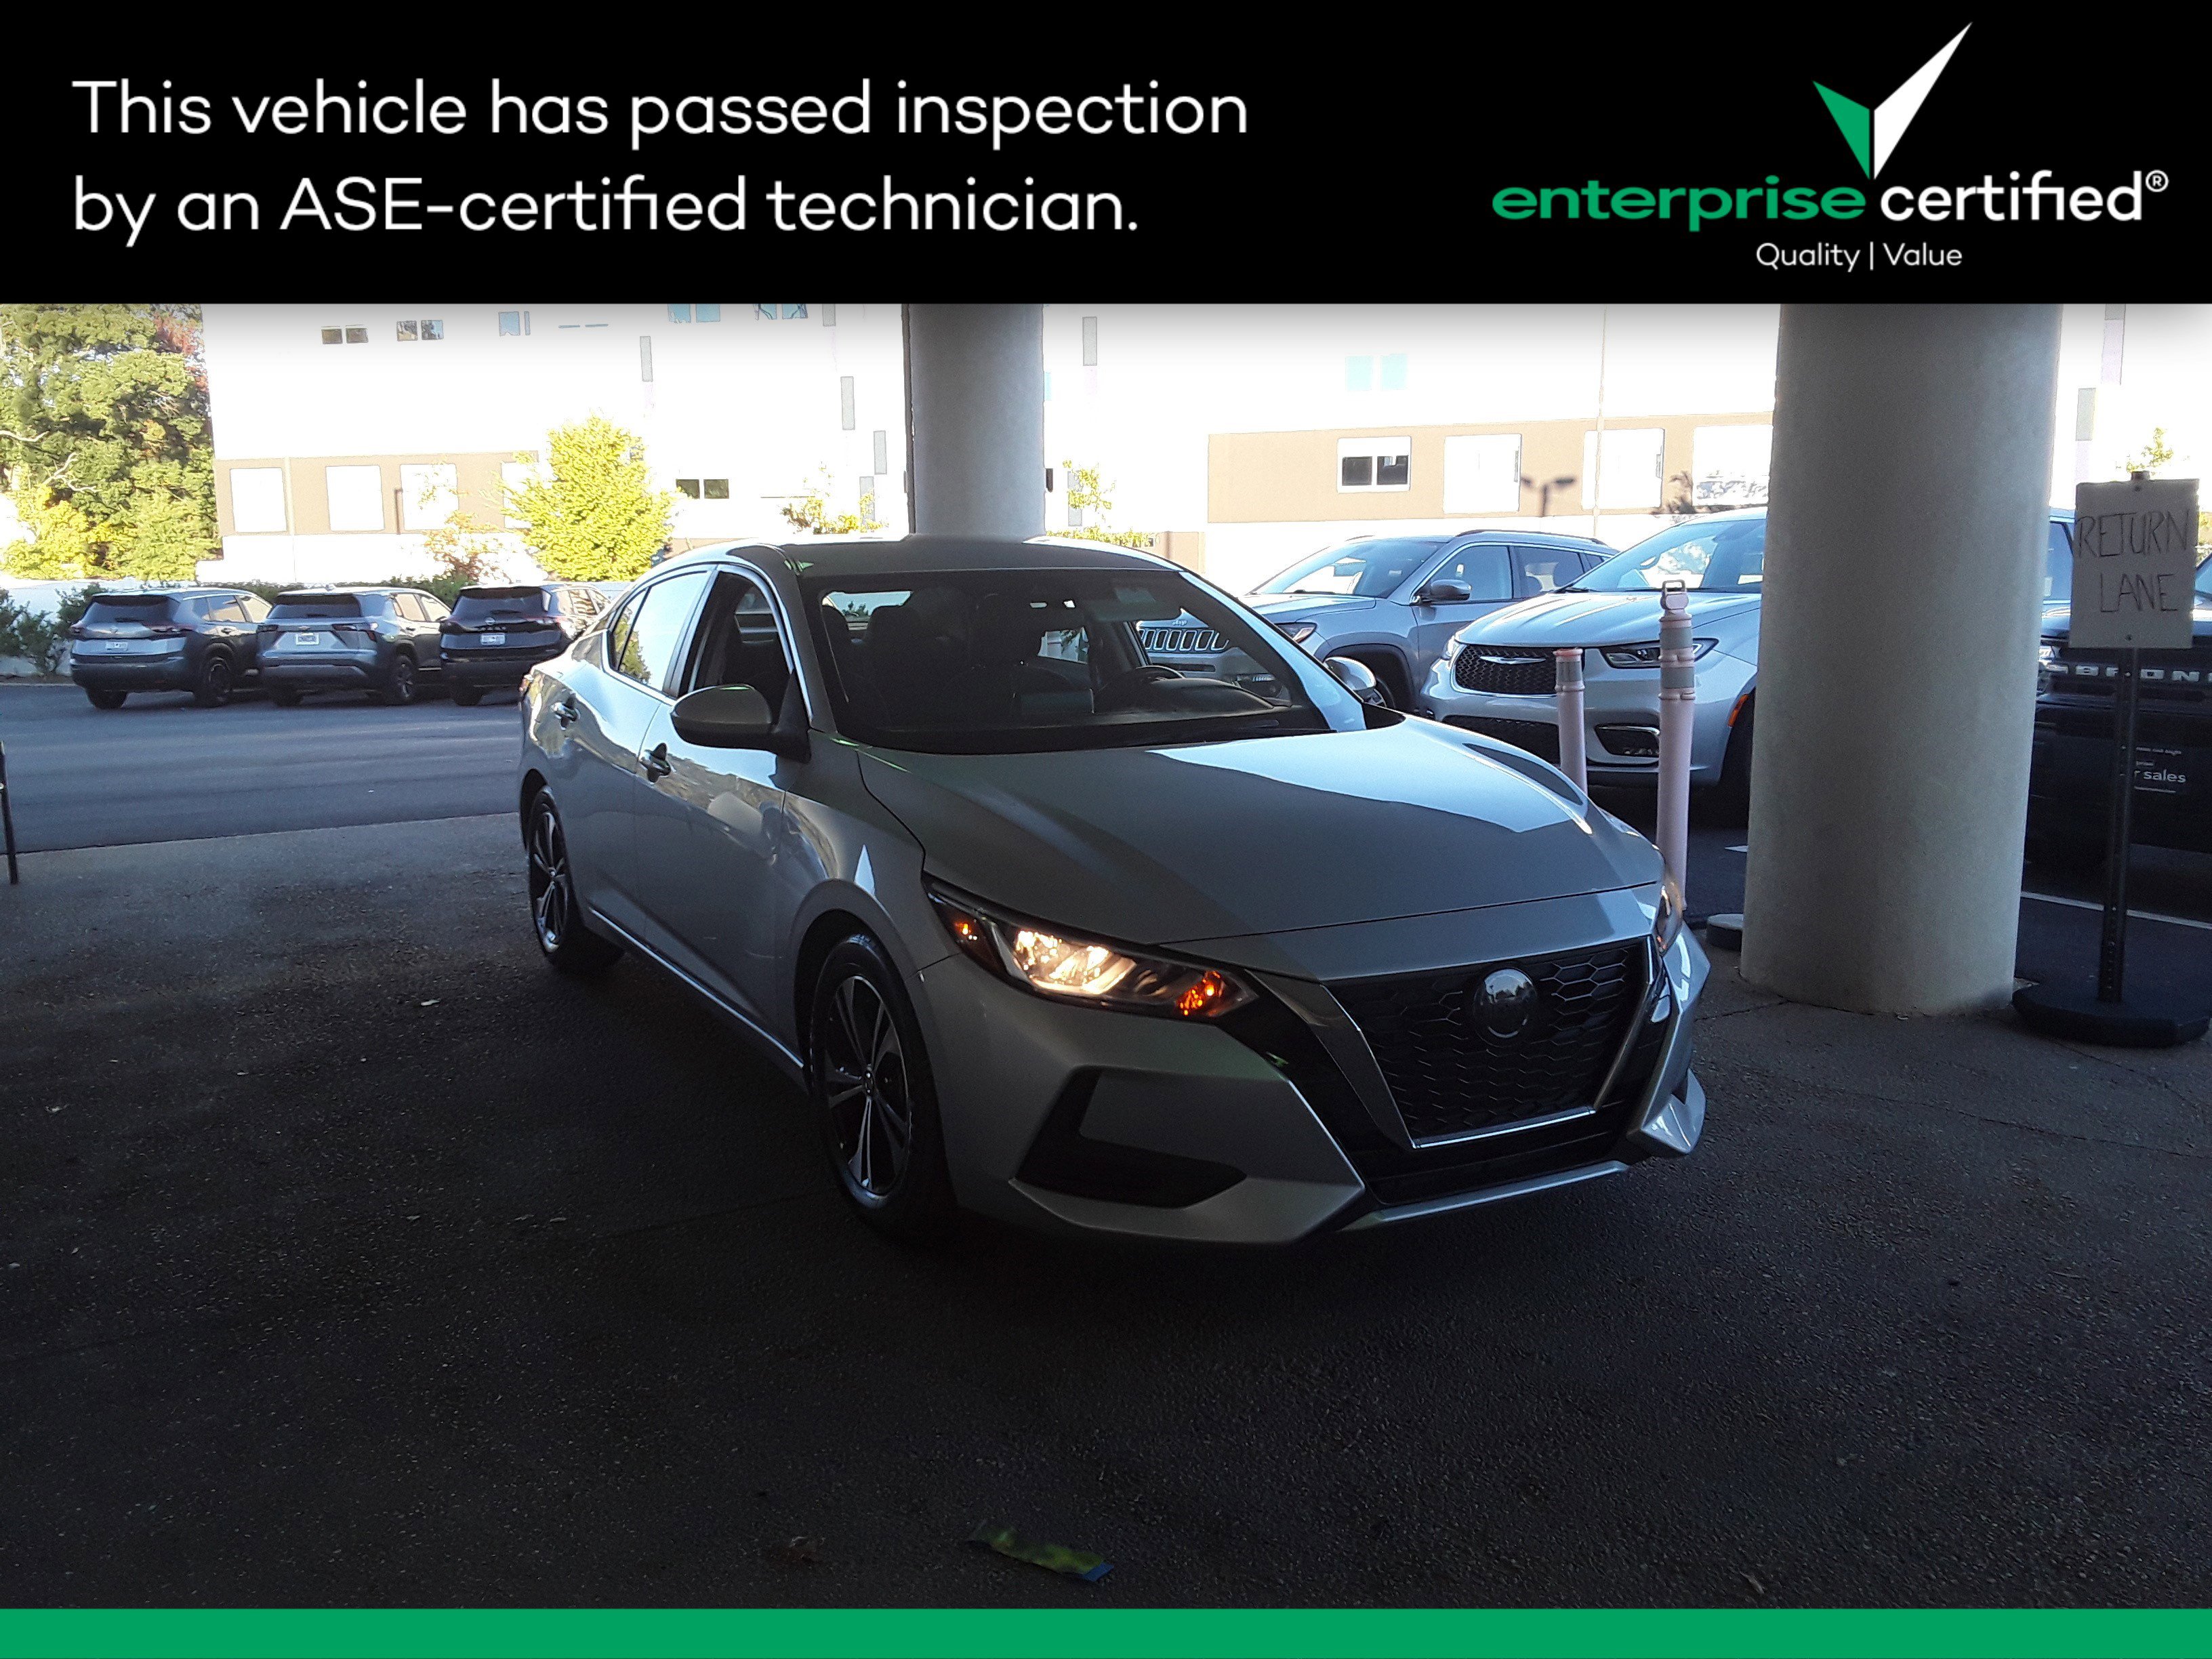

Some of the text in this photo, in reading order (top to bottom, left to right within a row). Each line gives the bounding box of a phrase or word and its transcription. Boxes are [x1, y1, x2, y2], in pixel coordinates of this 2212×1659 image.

[2077, 510, 2189, 558] RETURN
[2101, 573, 2177, 613] LANE
[2075, 665, 2212, 683] BON
[2143, 769, 2186, 783] sales
